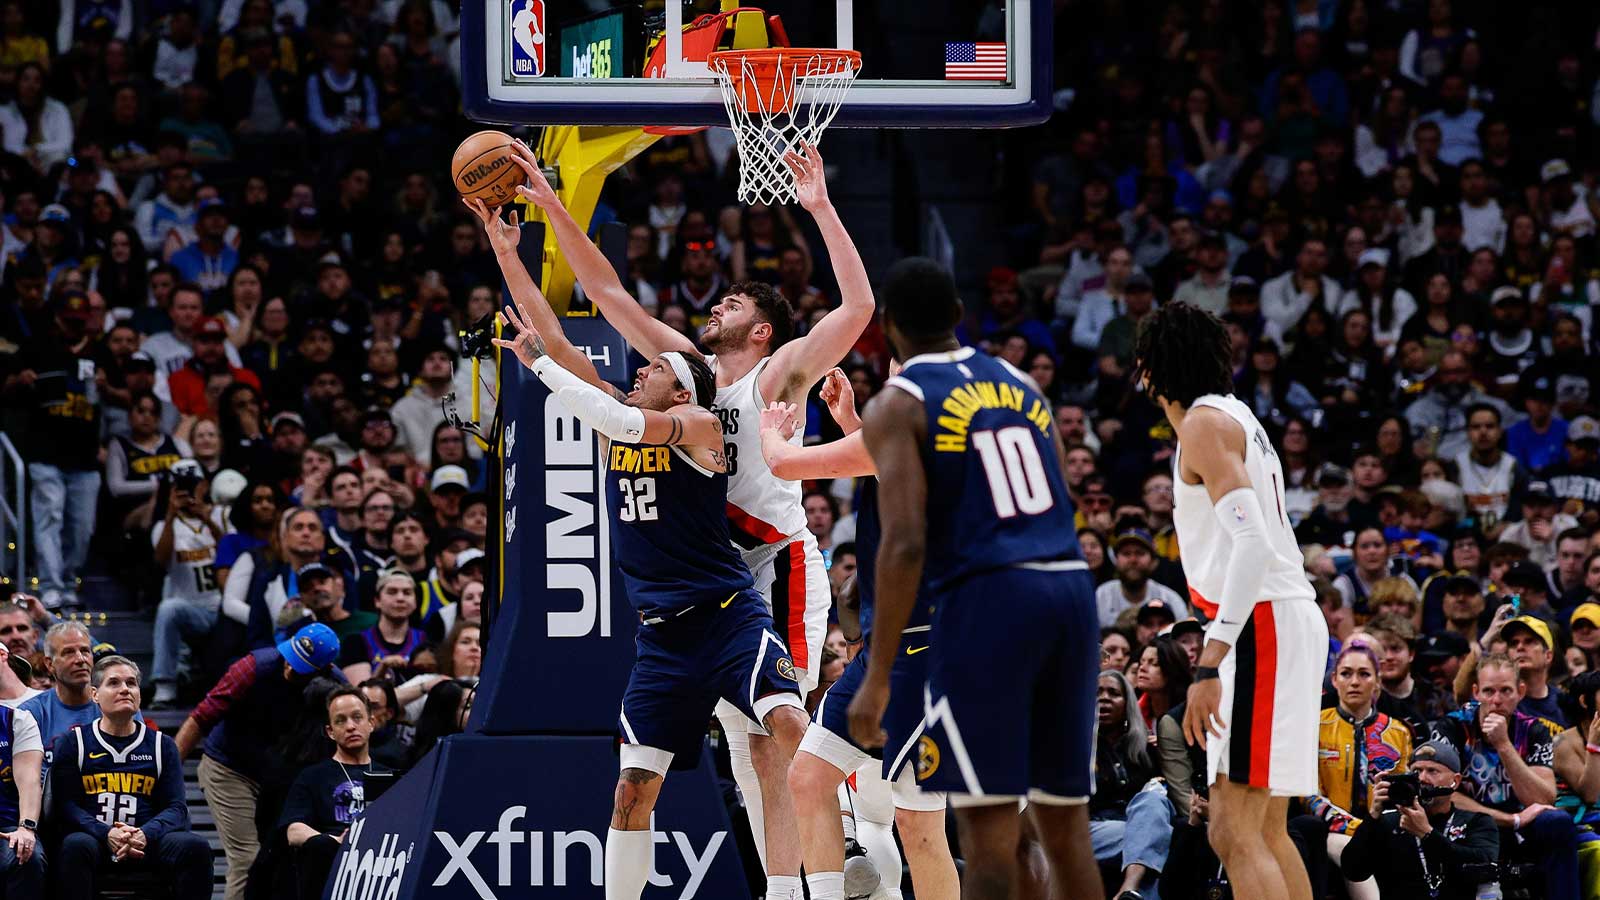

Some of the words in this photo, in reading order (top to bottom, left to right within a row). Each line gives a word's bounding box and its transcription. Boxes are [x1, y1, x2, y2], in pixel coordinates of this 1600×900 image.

[515, 59, 532, 72] NBA
[573, 38, 612, 78] bet365
[462, 156, 509, 187] Wilson
[935, 381, 1025, 452] HARDAWAY
[1026, 399, 1051, 439] JR.
[611, 445, 672, 474] DENVER
[972, 426, 1054, 519] 10
[544, 392, 597, 638] UMB
[619, 477, 659, 522] 32
[194, 567, 217, 592] 15
[130, 753, 153, 762] ibotta
[82, 772, 156, 796] DENVER
[96, 792, 138, 825] 32
[431, 805, 728, 900] xfinty
